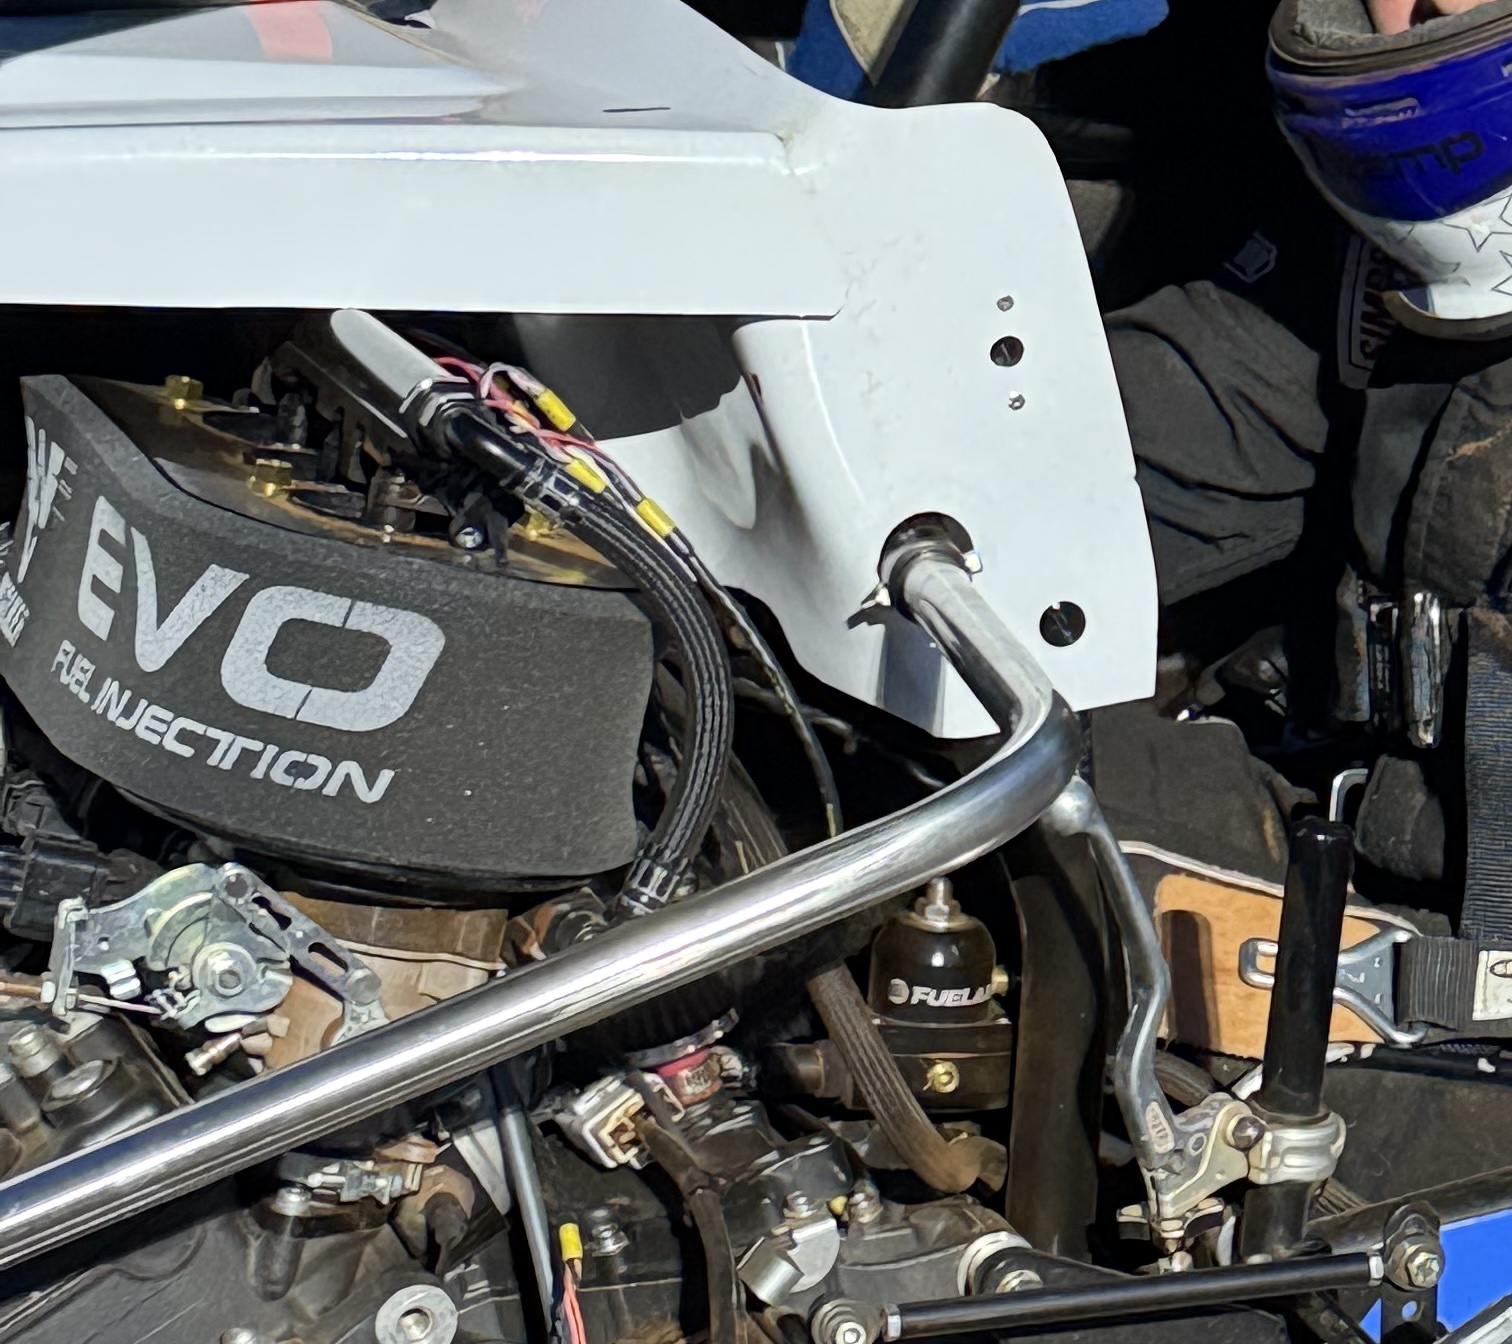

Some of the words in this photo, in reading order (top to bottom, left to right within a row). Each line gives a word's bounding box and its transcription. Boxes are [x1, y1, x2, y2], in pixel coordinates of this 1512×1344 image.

[78, 495, 446, 733] EVO
[50, 639, 97, 703] FUEL
[91, 677, 396, 805] INJECTION
